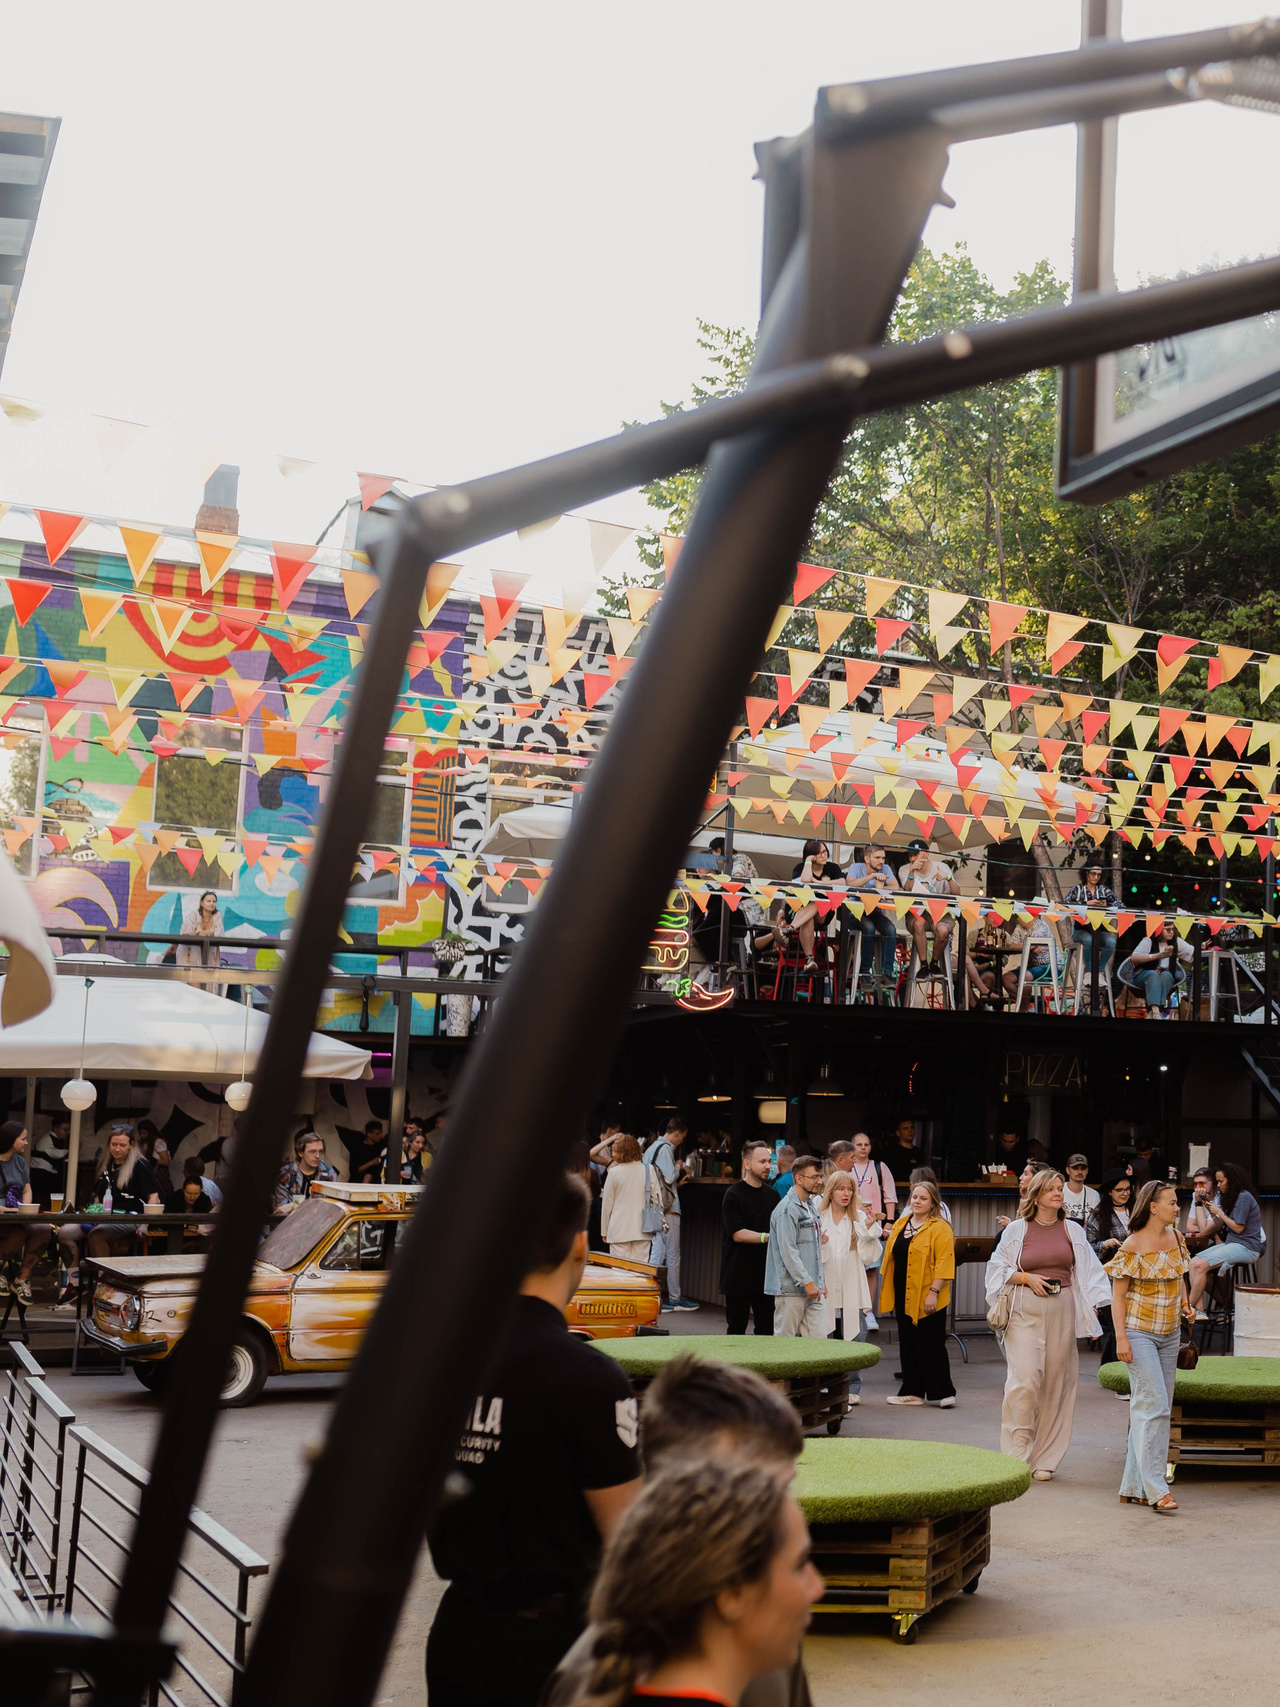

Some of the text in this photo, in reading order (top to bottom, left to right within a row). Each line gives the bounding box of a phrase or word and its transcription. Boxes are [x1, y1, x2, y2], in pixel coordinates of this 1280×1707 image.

[1006, 1051, 1081, 1088] PIZZA
[464, 1395, 503, 1435] LA
[455, 1449, 485, 1465] QUAD
[460, 1435, 501, 1452] CURITY
